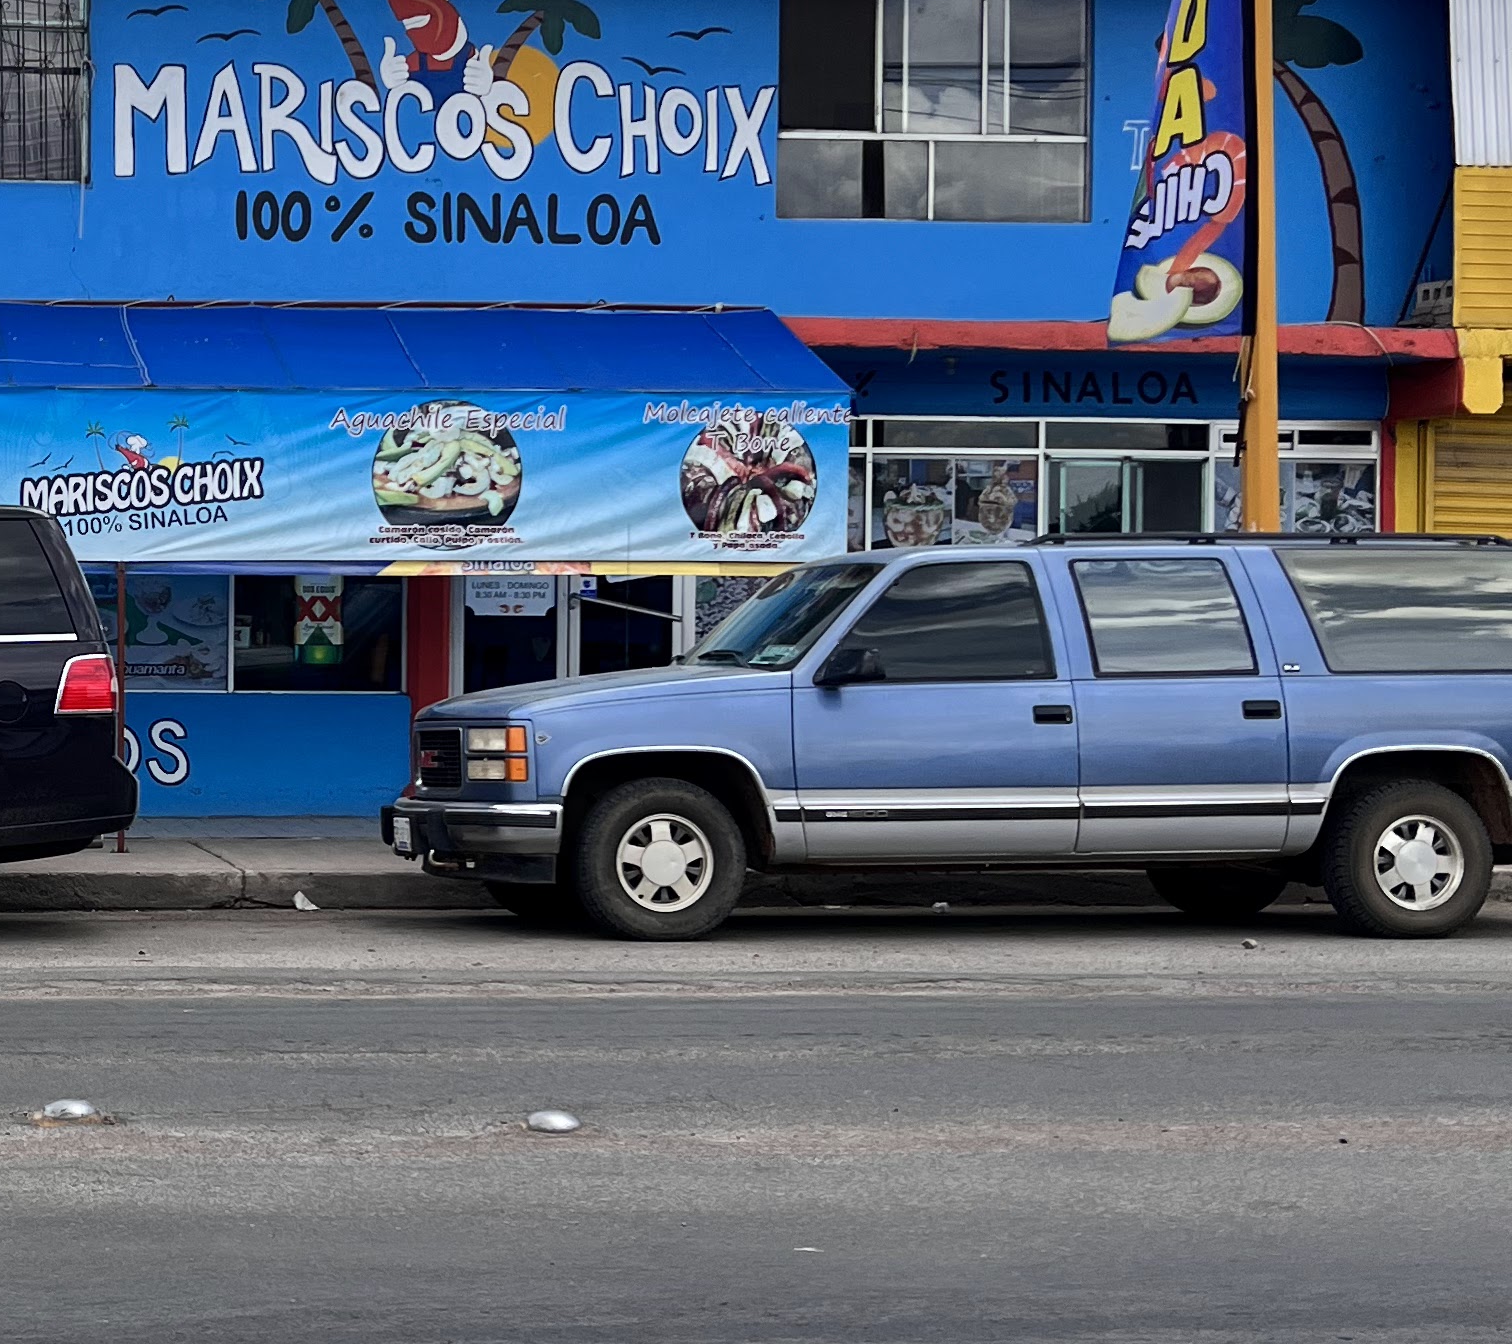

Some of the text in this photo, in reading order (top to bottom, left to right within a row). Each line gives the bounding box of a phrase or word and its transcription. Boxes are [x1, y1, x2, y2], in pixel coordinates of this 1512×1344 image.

[112, 58, 776, 185] MARISCOS CHOIX
[403, 190, 662, 246] SINALOA
[989, 369, 1199, 406] SINALOA
[331, 405, 567, 438] Aguachile Especial
[643, 400, 853, 428] Molcajete caliente
[732, 431, 790, 453] Bone
[20, 458, 263, 516] MARISCOS CHOIX
[64, 506, 227, 537] 100% SINALOA
[124, 664, 185, 675] uamanta
